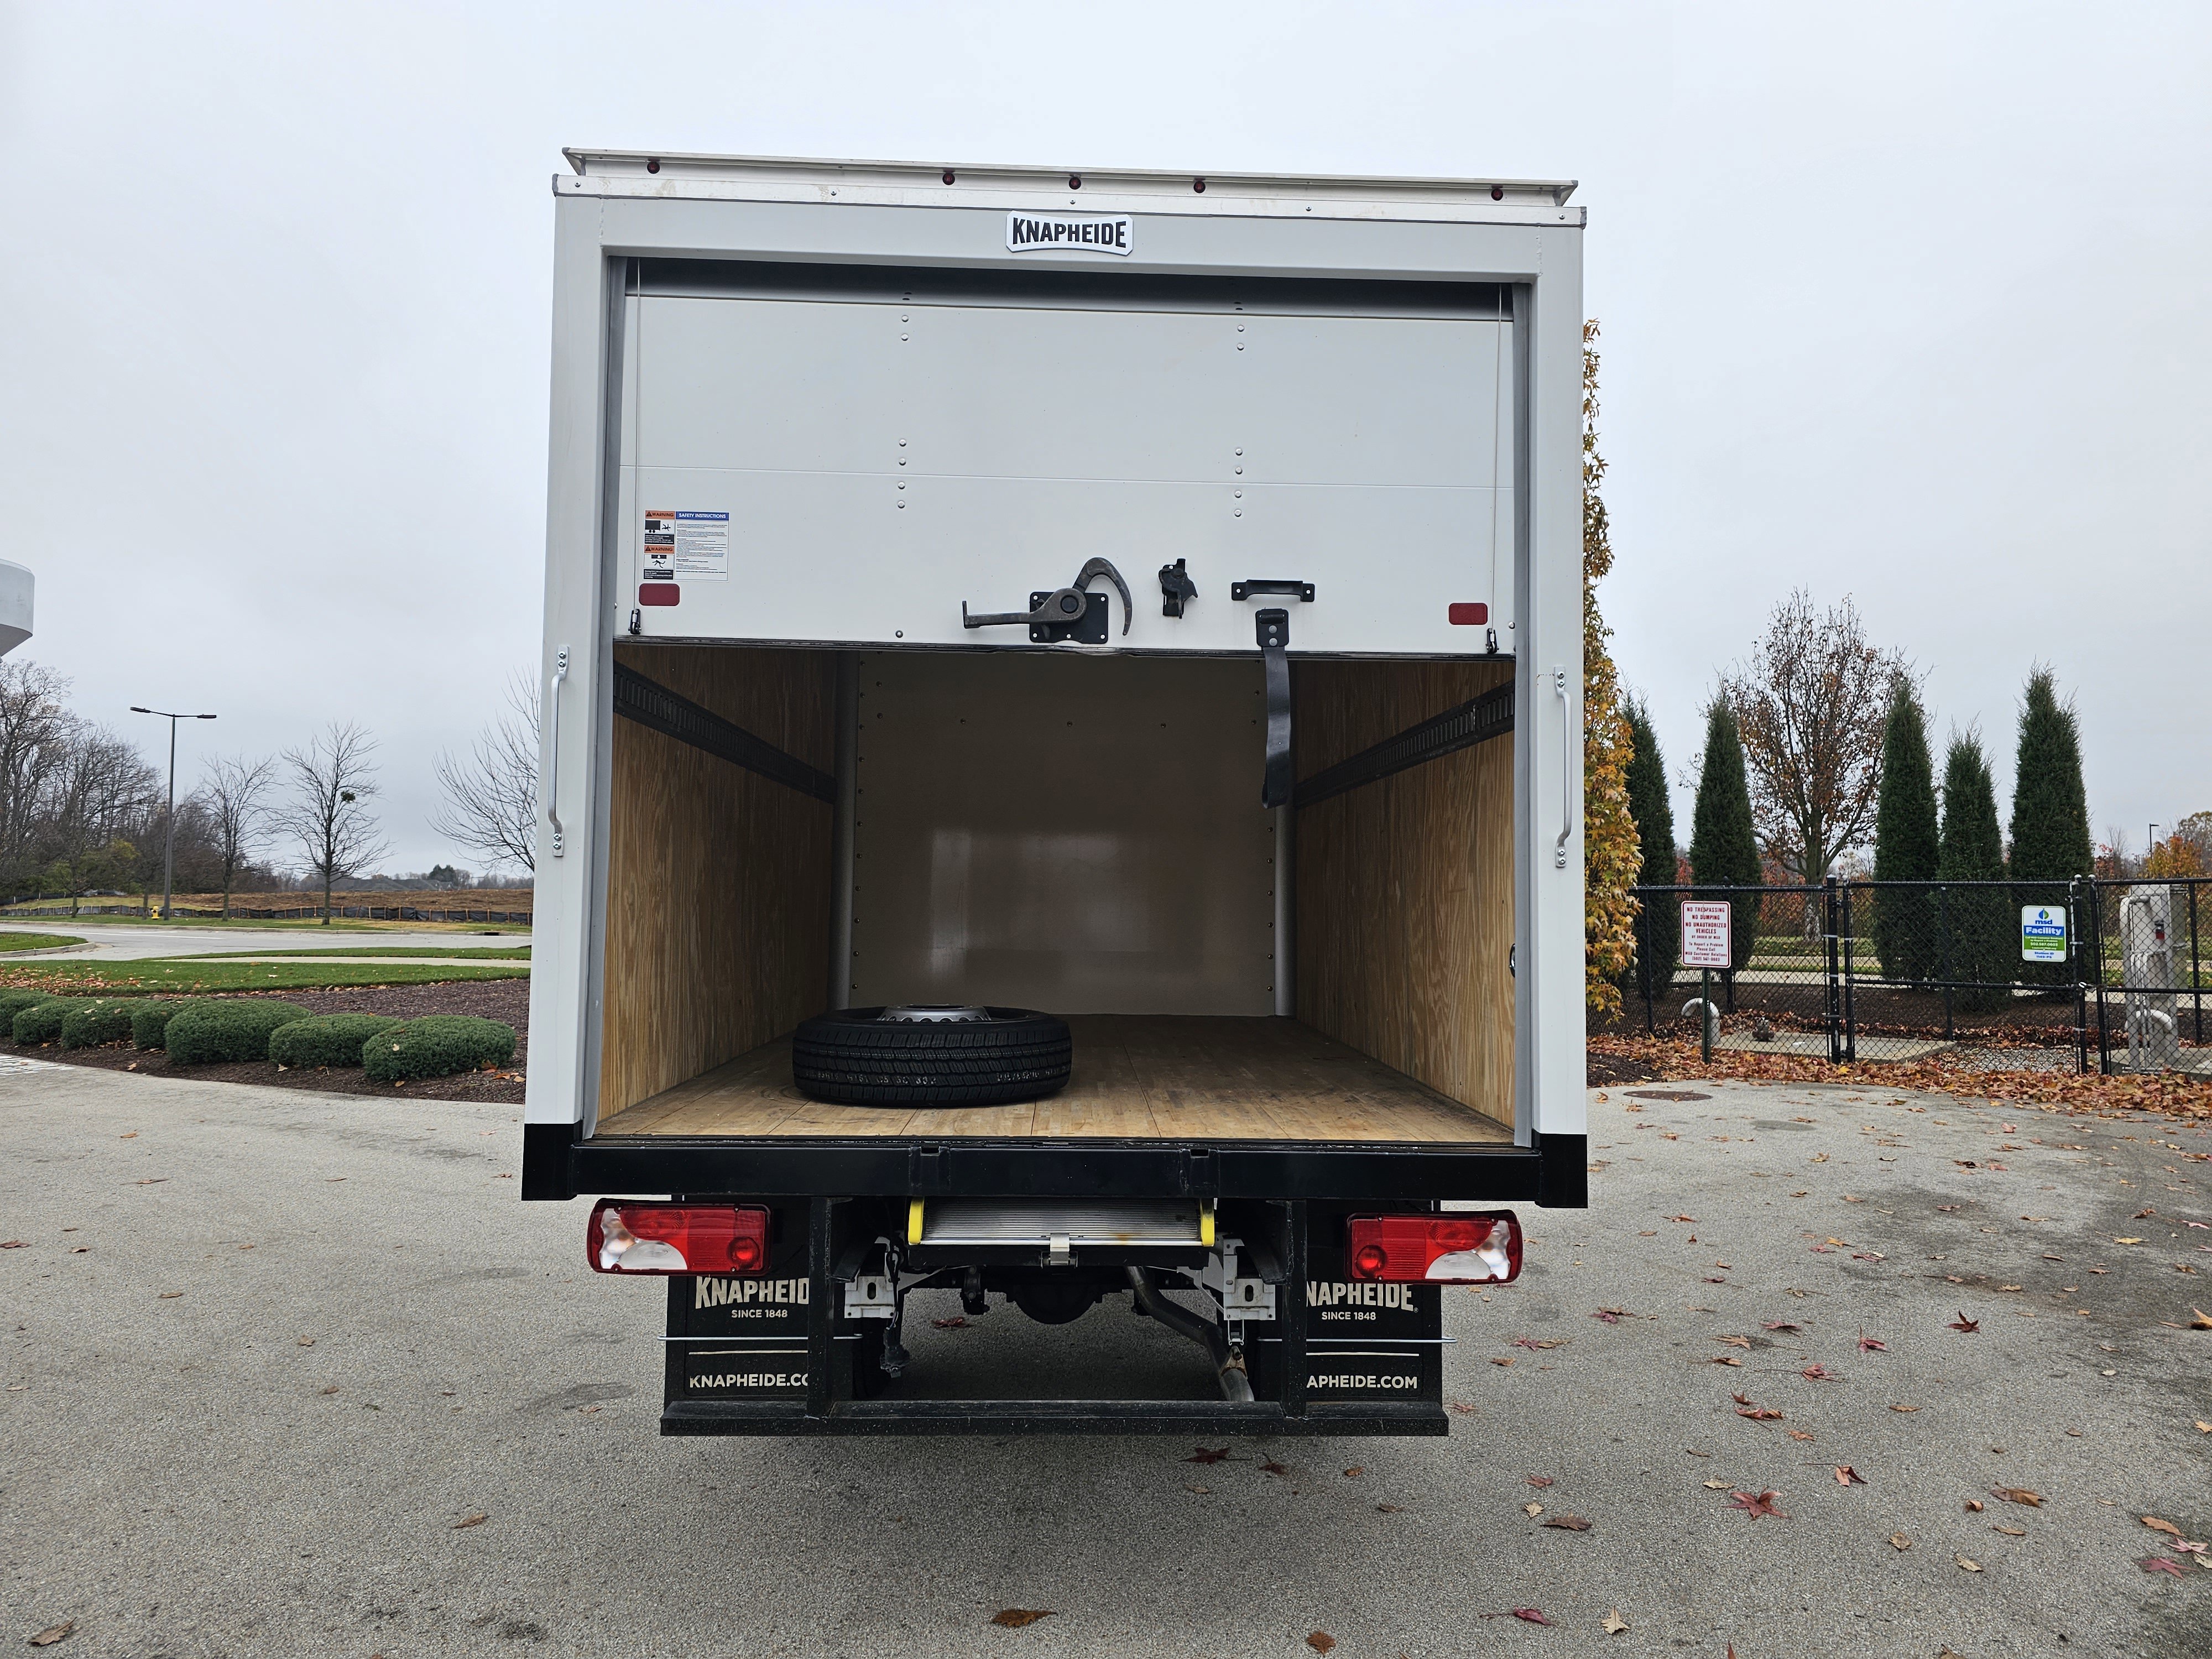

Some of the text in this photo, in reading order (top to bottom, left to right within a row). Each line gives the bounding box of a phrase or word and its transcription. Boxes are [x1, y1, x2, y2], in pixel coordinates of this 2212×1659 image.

[1013, 217, 1126, 248] KNAPHEIDE
[2026, 927, 2062, 936] Facility
[695, 1275, 810, 1309] KNAPHEID
[1306, 1280, 1413, 1312] NAPHEIDE
[731, 1309, 788, 1318] SINCE 1848
[1321, 1312, 1376, 1321] SINCE 1848
[690, 1373, 808, 1389] KNAPHEIDE.C
[1306, 1375, 1418, 1389] APHEIDE.COM
